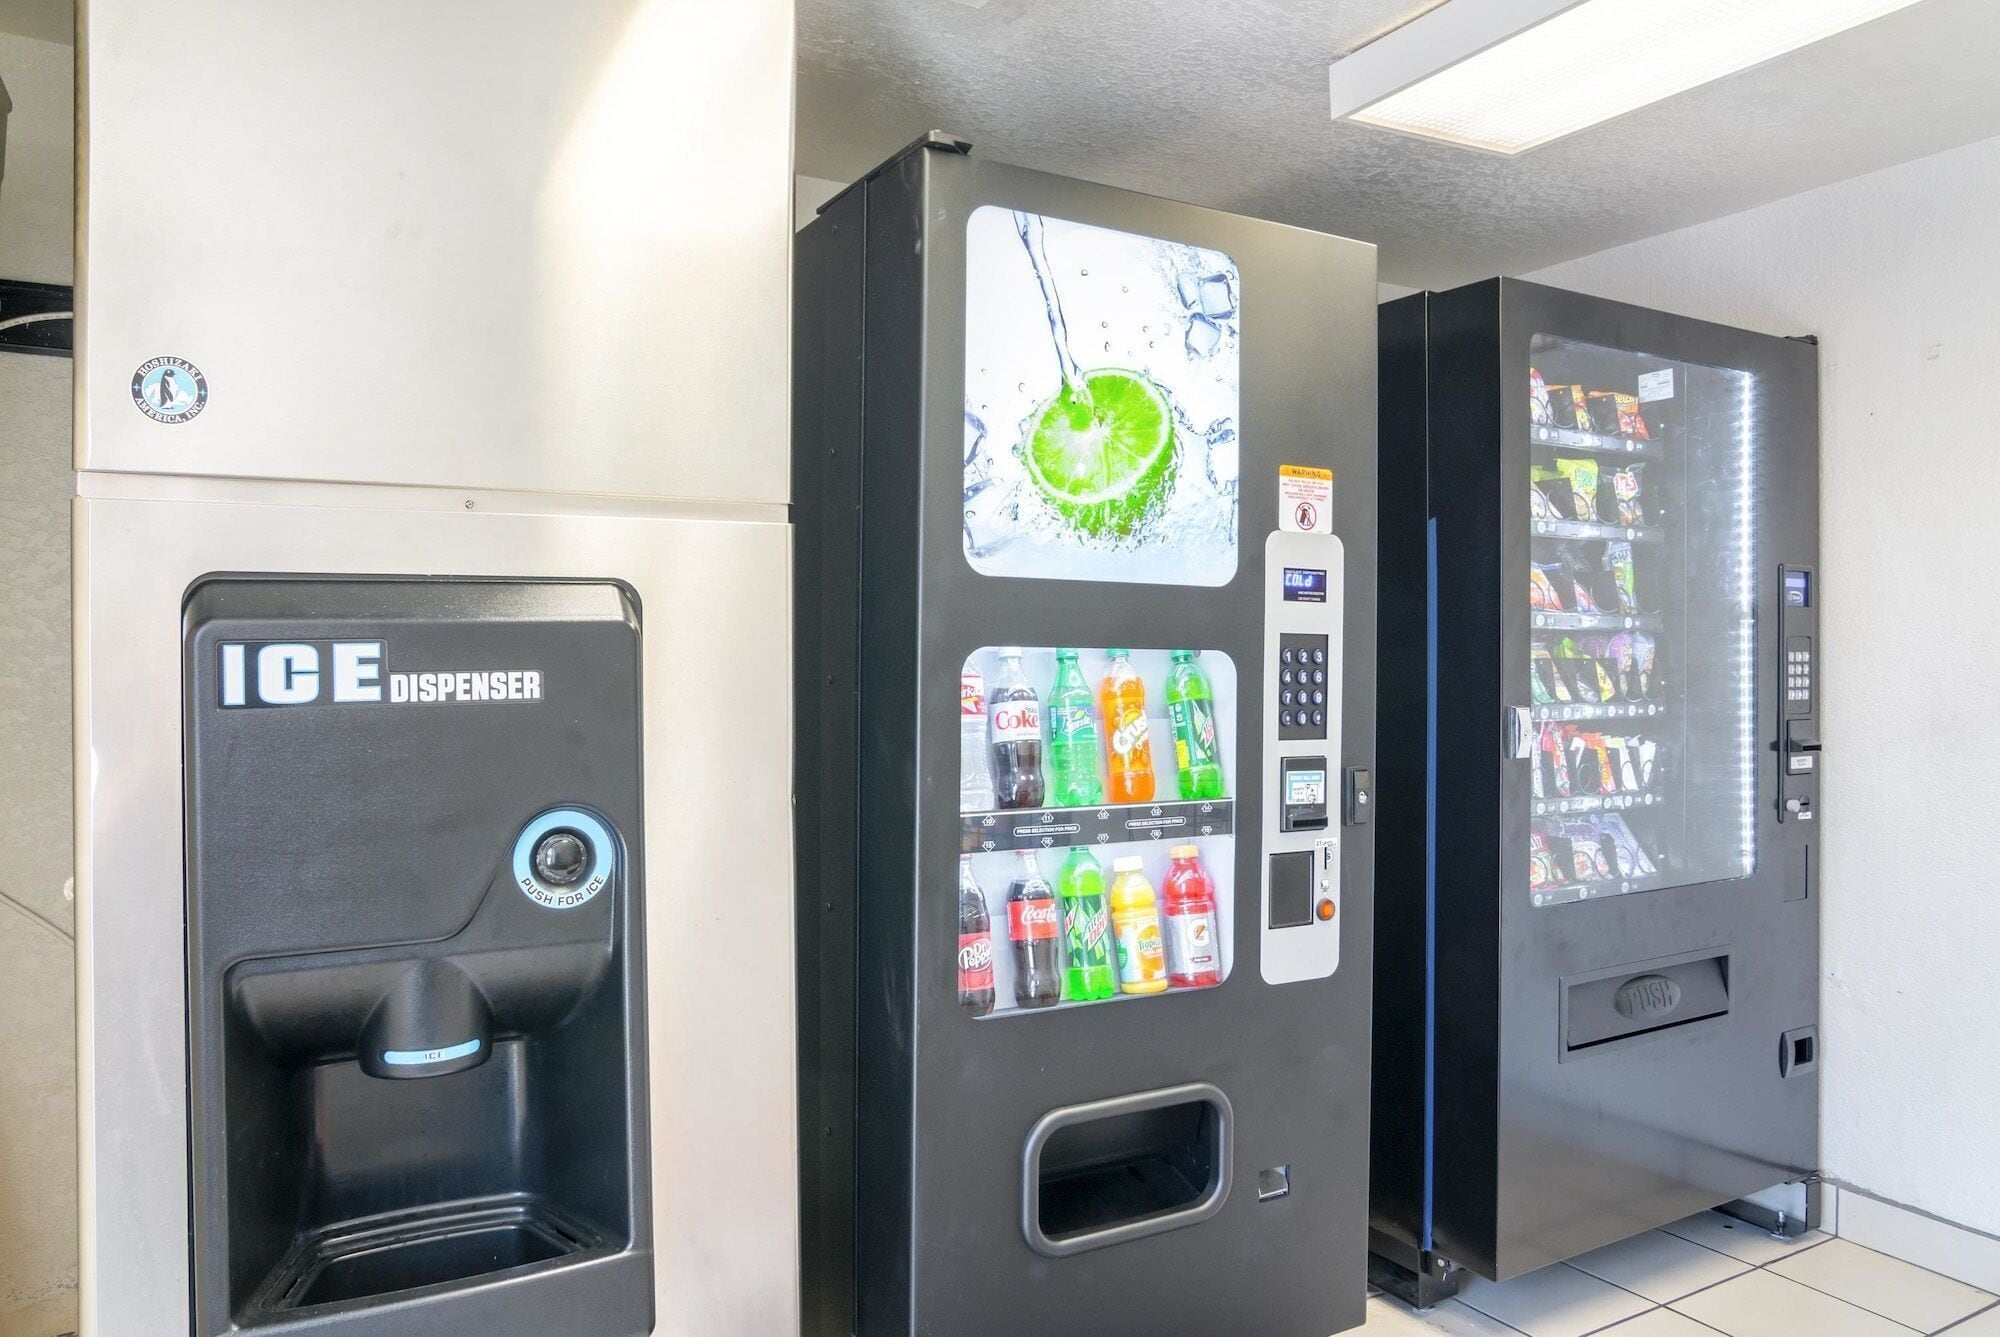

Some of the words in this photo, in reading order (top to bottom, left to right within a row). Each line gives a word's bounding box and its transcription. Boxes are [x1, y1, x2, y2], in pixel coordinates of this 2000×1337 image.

[137, 357, 203, 380] HOSHIZAKI
[135, 398, 187, 423] AMERICA,
[186, 401, 205, 419] INC.
[1291, 468, 1321, 478] WARNING
[222, 642, 381, 706] ICE
[390, 671, 541, 703] DISPENSER
[995, 709, 1039, 730] Coke
[1113, 708, 1148, 754] Crus
[521, 877, 553, 904] PUSH
[558, 892, 584, 905] FOR
[586, 875, 604, 895] ICE
[973, 942, 987, 955] Dr
[1624, 979, 1672, 1015] PUSH
